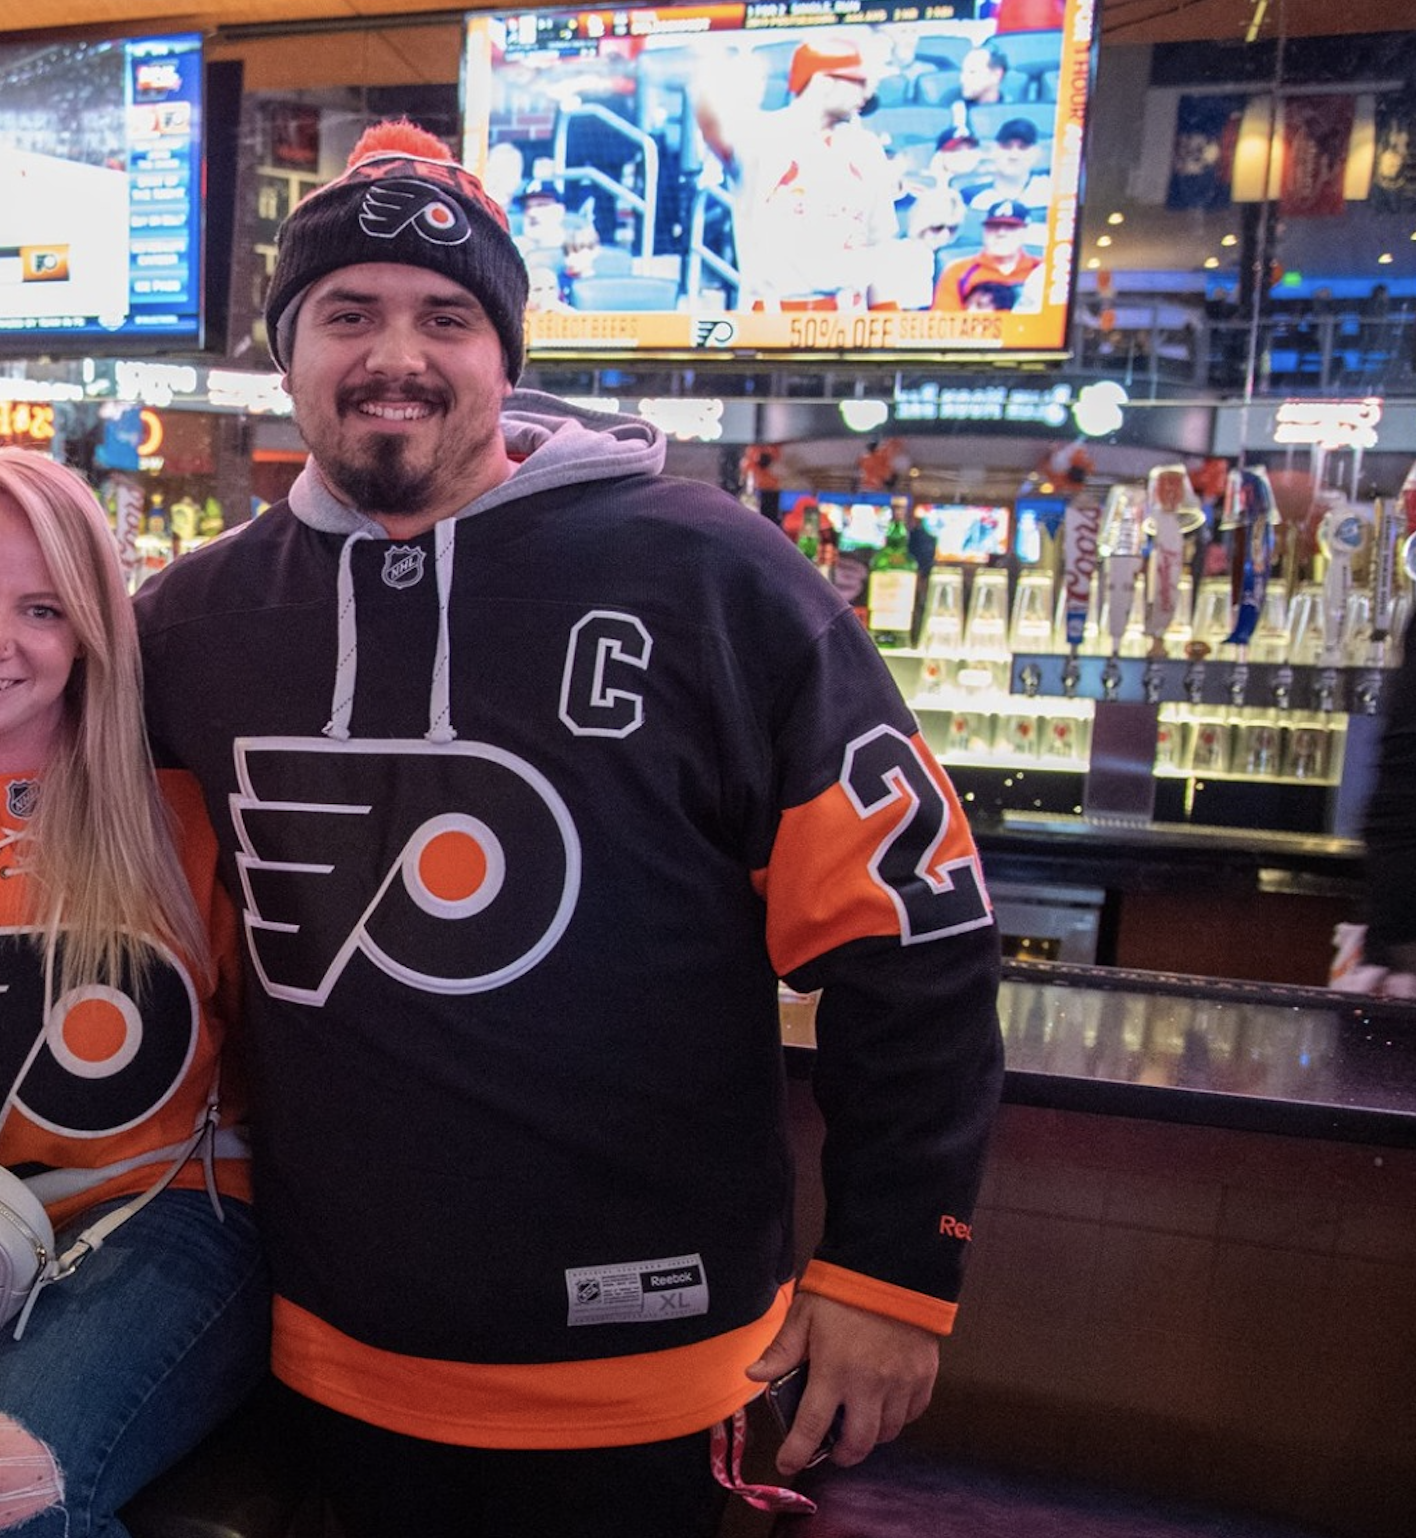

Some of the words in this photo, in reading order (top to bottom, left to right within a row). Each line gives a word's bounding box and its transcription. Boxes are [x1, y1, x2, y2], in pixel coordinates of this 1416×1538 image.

[1070, 60, 1088, 119] HOUR
[590, 316, 638, 338] BEERS
[790, 318, 846, 347] 50%
[854, 317, 892, 347] OFF
[898, 316, 956, 339] SELECT
[959, 316, 1003, 339] APPS
[1065, 507, 1101, 602] Coors
[558, 610, 653, 738] C
[838, 723, 993, 947] 2
[650, 1271, 693, 1288] Reebok
[660, 1292, 691, 1311] XL
